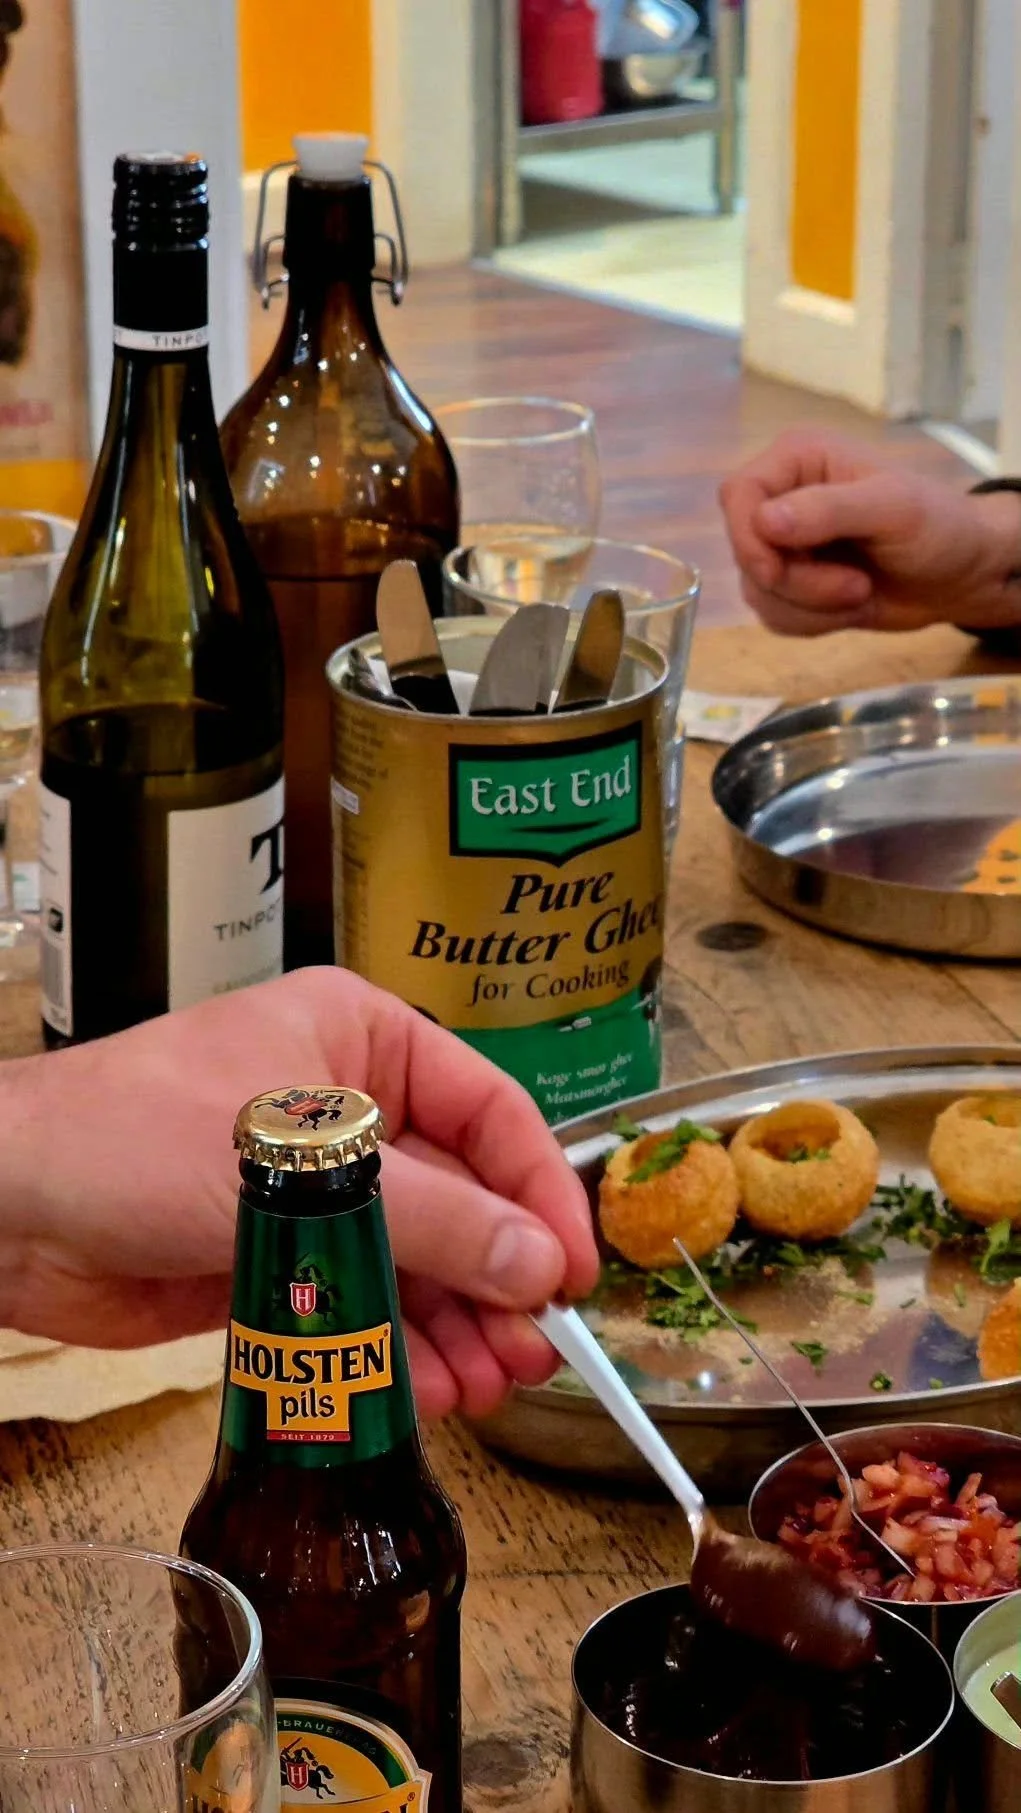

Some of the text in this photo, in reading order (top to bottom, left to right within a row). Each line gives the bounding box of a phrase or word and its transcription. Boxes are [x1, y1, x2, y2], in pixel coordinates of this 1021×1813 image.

[470, 755, 632, 817] East End
[500, 871, 615, 915] Pure
[408, 919, 571, 966] Butter
[467, 958, 632, 1008] for Cooking
[234, 1333, 386, 1385] HOLSTEN
[279, 1386, 336, 1426] pils
